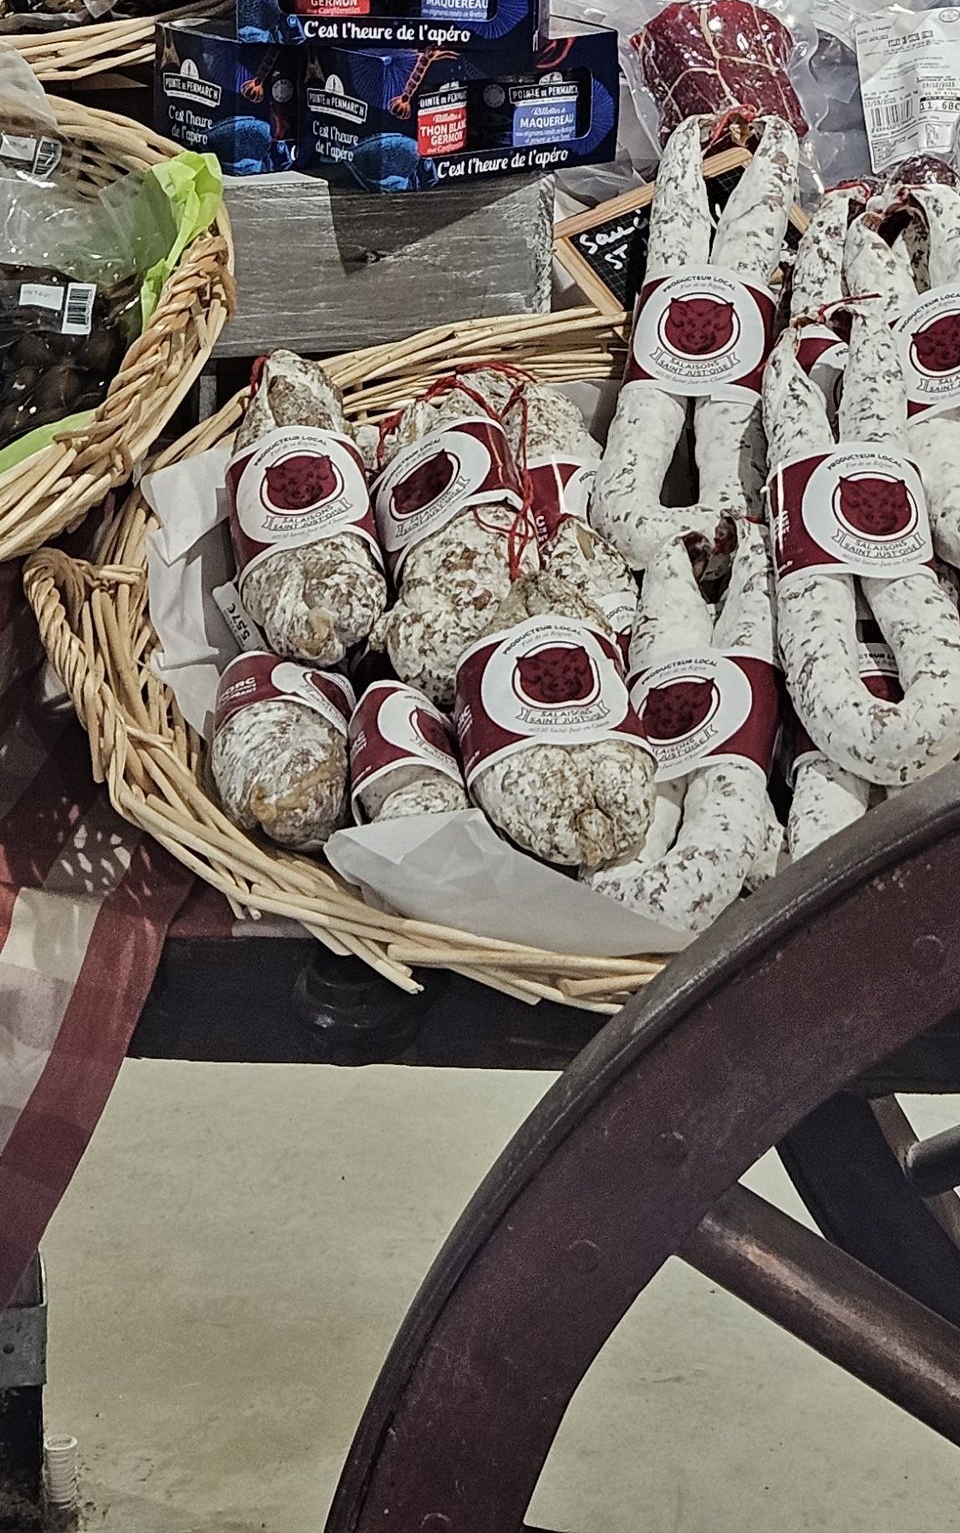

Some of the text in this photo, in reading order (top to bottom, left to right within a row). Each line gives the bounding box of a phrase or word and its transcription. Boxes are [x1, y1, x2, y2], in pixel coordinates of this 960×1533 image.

[304, 21, 471, 45] C'est l'heure de l'apéro
[419, 95, 440, 108] OINTE
[920, 101, 960, 111] 11,68€
[520, 114, 574, 128] MAQUEREAU
[420, 125, 449, 137] THON
[437, 147, 568, 179] C'est l'heure de l'apéro
[663, 275, 736, 292] PRODUCTEUR LOCAL
[898, 298, 939, 332] PRODUCTEUR
[660, 359, 682, 375] SAINT
[671, 357, 720, 369] SALAISONS
[930, 383, 954, 392] SAINT
[253, 435, 327, 466] PRODUCTEUR LOCAL
[827, 453, 902, 470] PRODUCTEUR LOCAL
[282, 504, 334, 524] SALAISONS
[273, 521, 300, 531] SAINT
[845, 543, 870, 558] SAINT
[855, 539, 908, 551] SALAISONS
[502, 625, 582, 655] PRODUCTEUR LOCAL
[641, 659, 718, 685] PRODUCTEUR LOCAL
[529, 716, 558, 724] SAINT
[540, 709, 592, 718] SALAISONS
[652, 737, 696, 756] LAISONS
